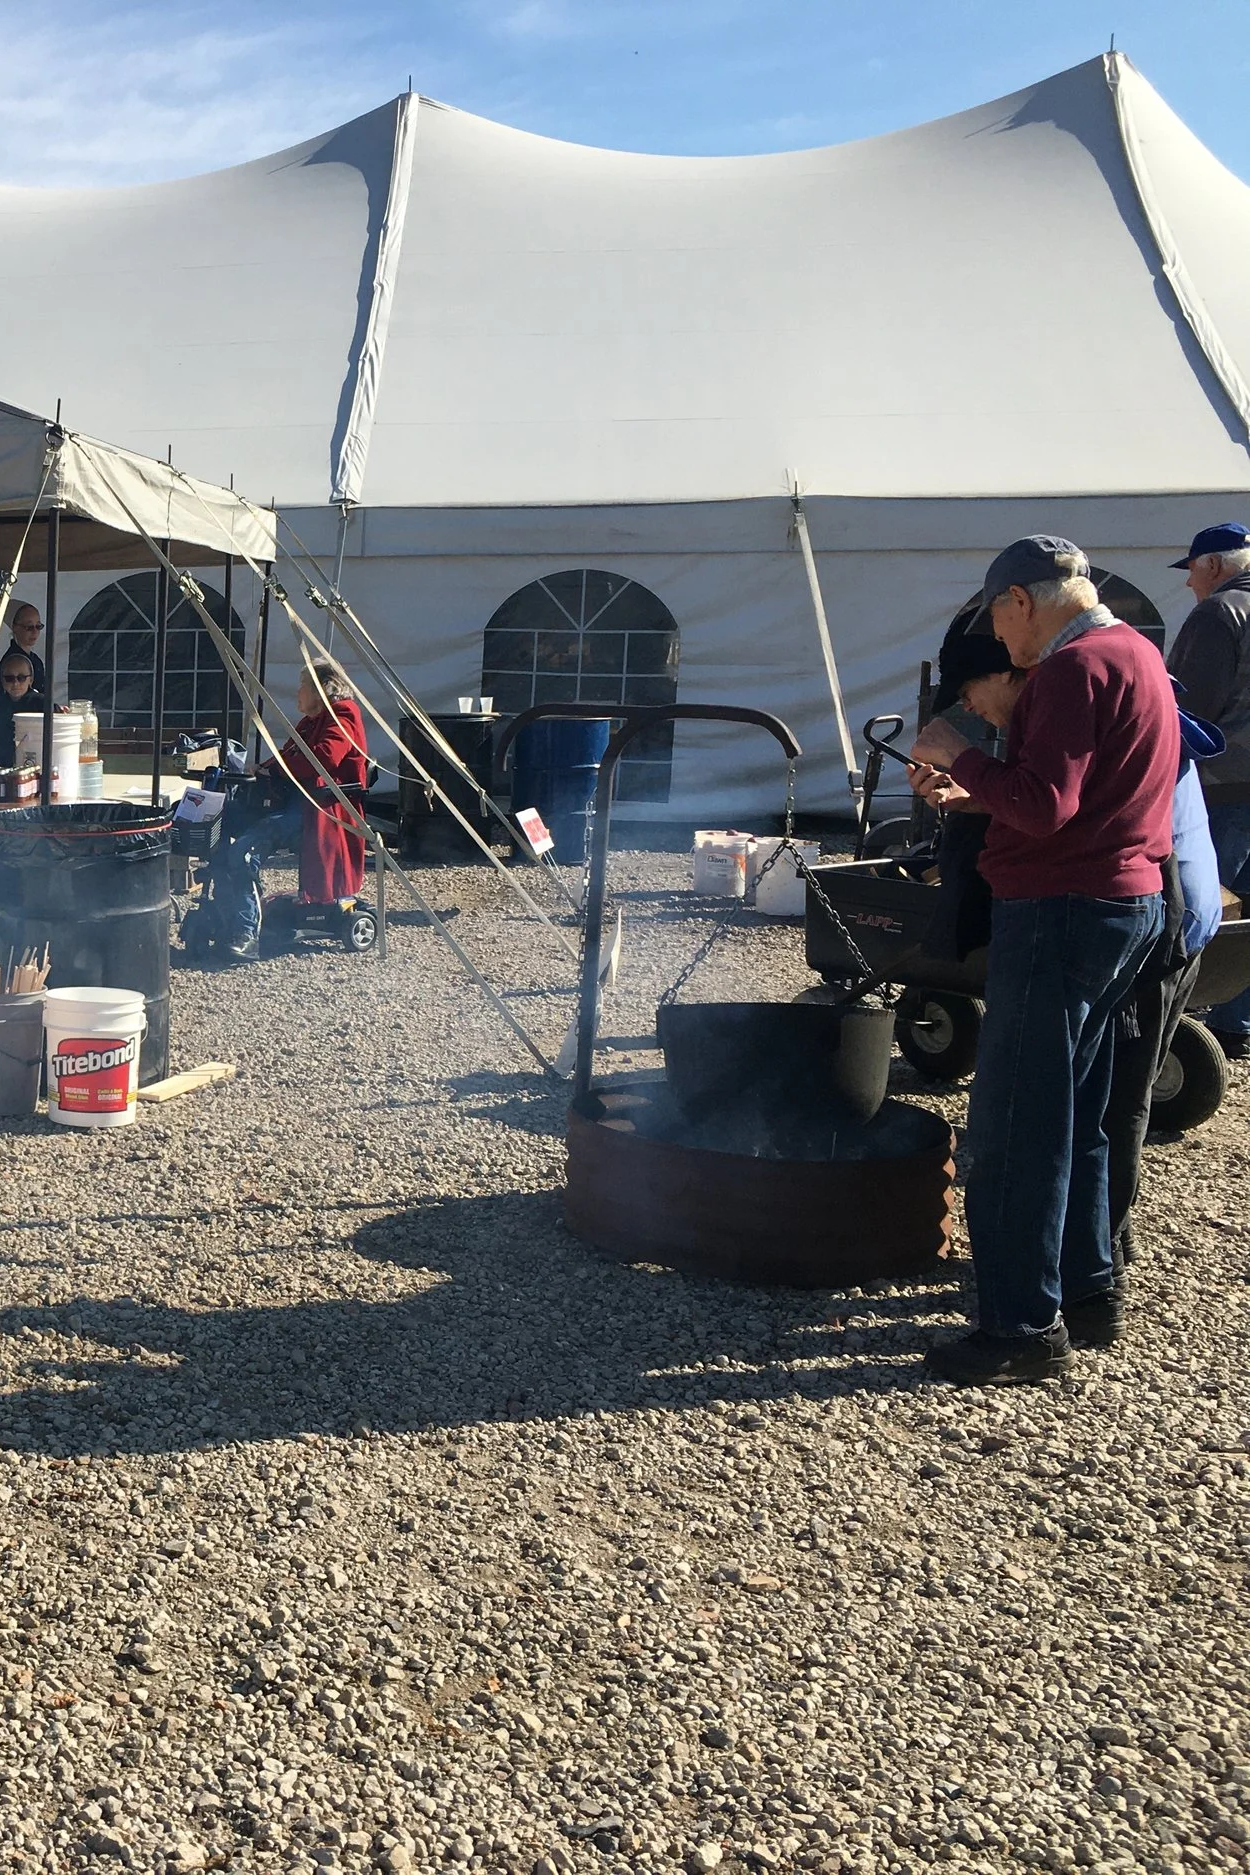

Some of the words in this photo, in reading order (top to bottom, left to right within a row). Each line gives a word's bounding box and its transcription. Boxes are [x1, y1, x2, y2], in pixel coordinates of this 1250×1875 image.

[707, 855, 728, 864] Dawn
[856, 912, 894, 928] LAPP
[52, 1038, 135, 1077] Titebond
